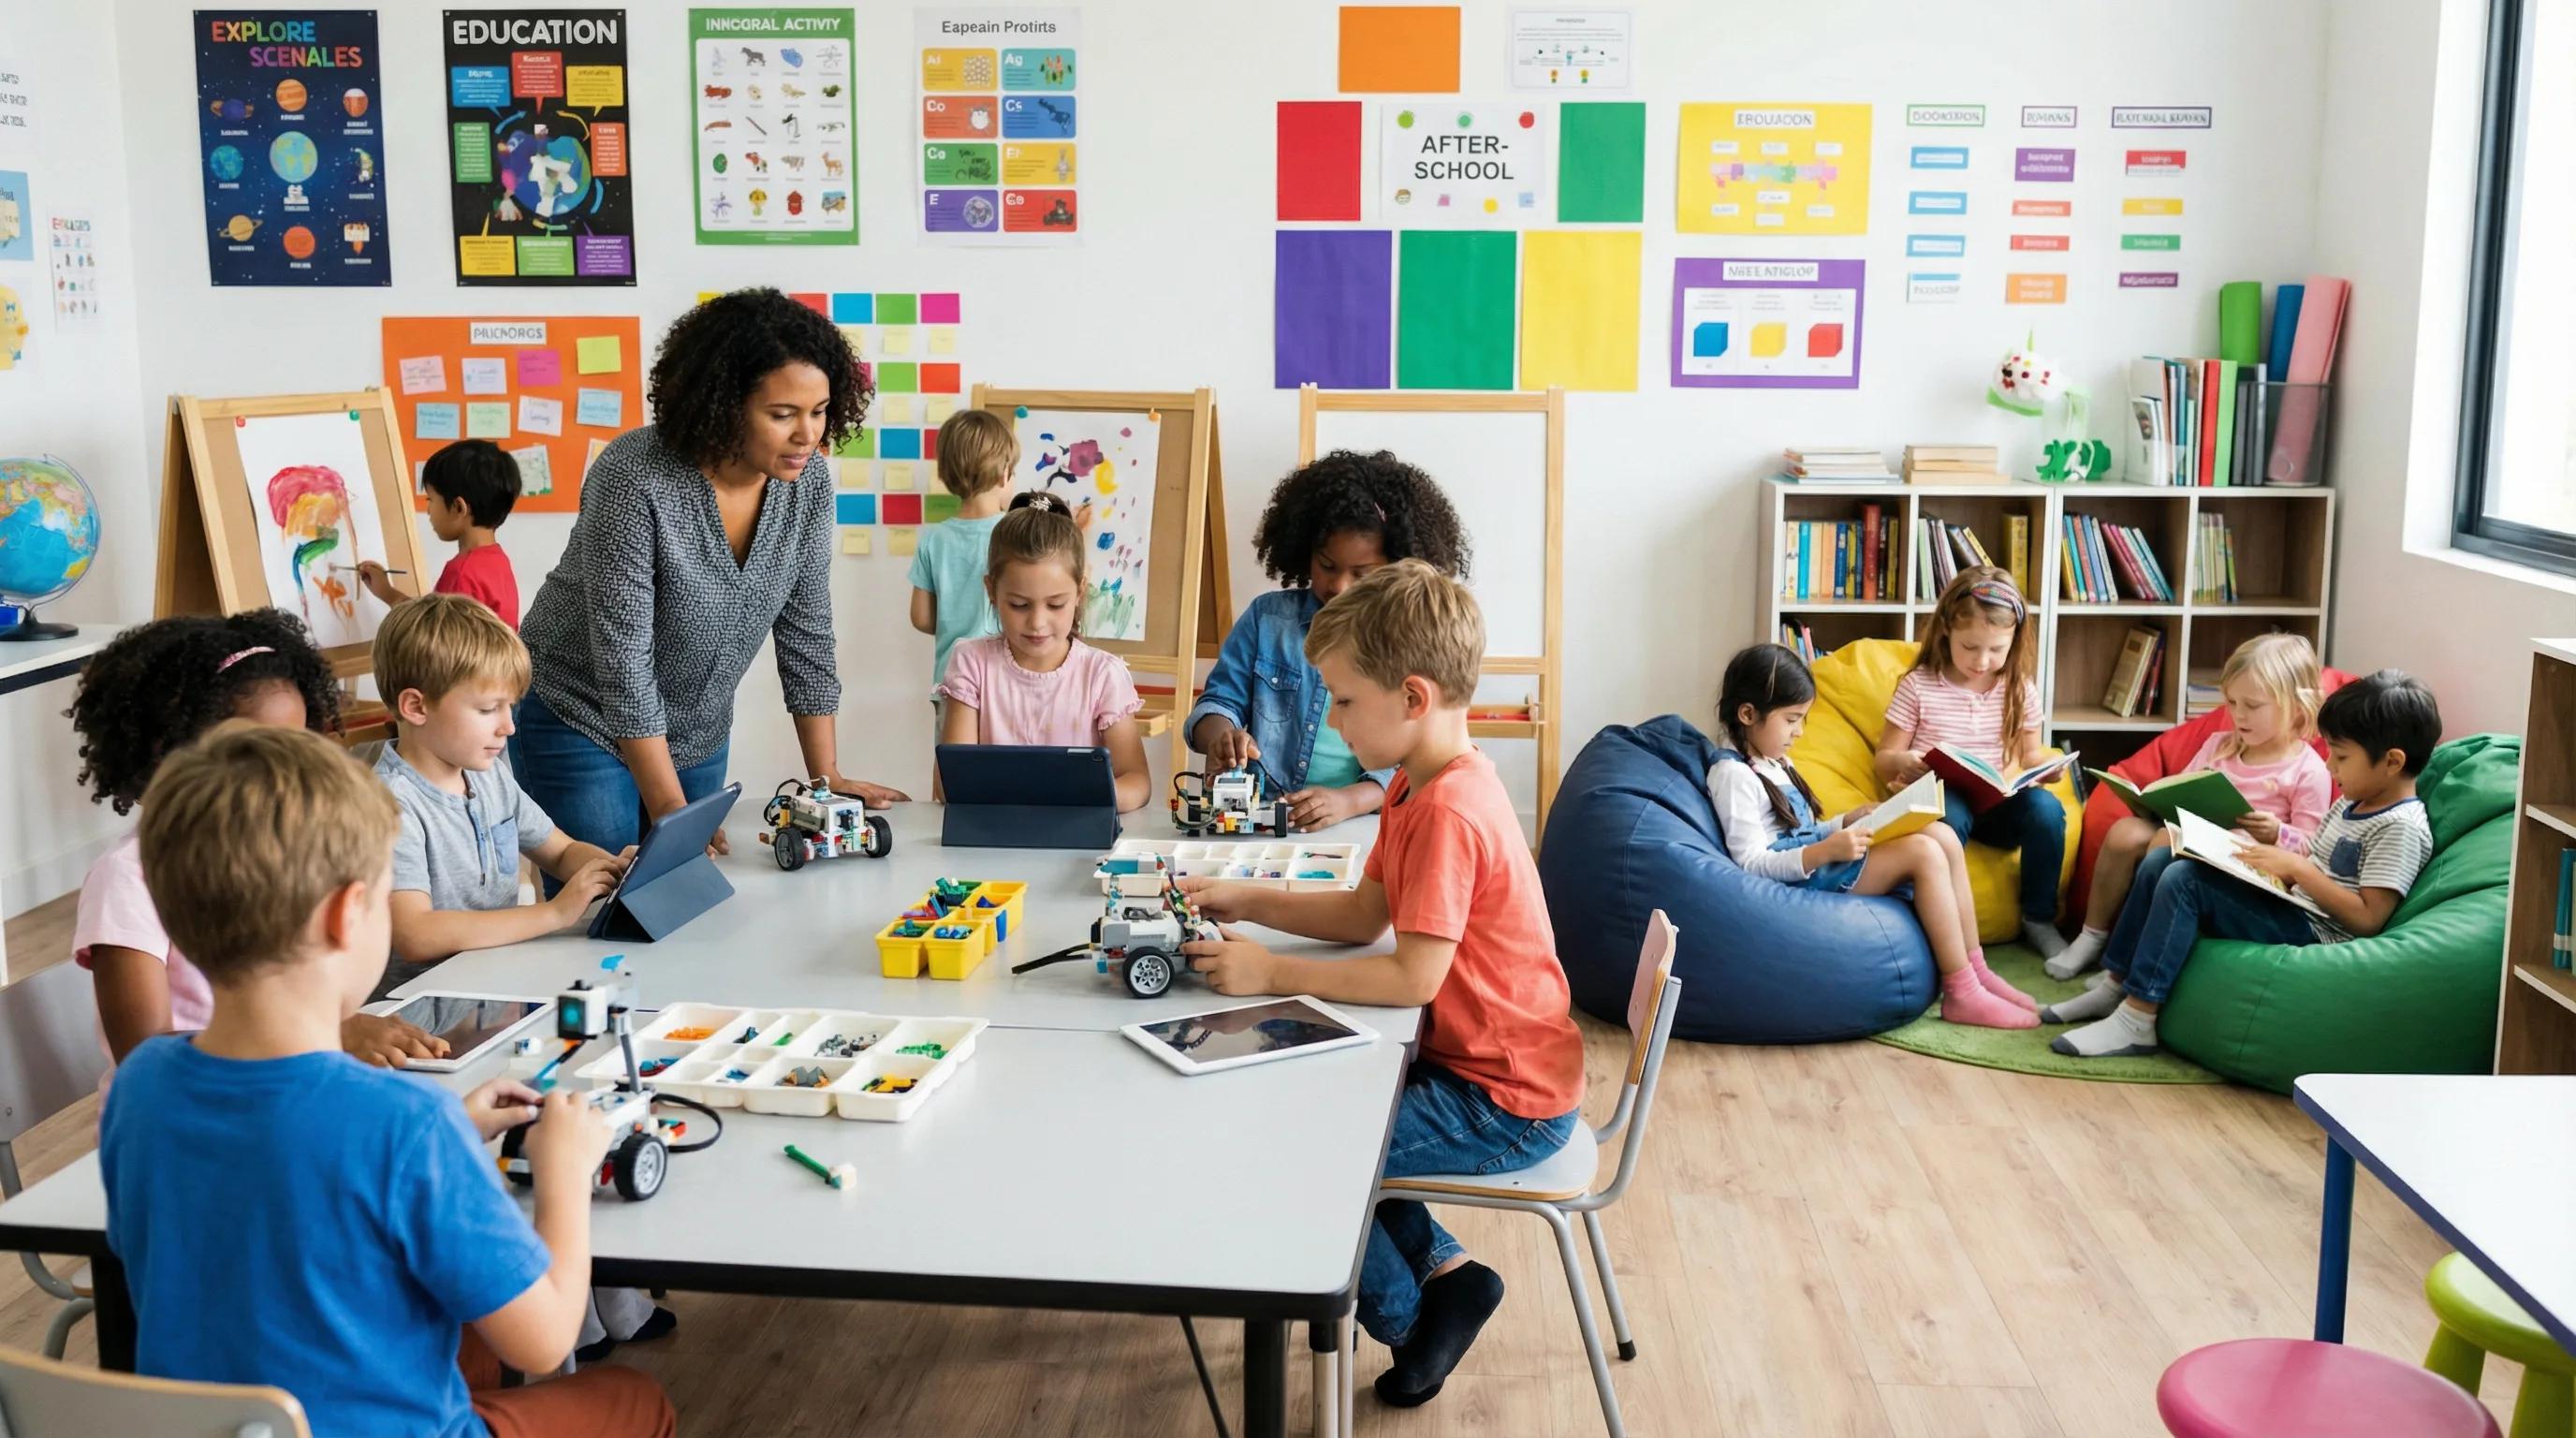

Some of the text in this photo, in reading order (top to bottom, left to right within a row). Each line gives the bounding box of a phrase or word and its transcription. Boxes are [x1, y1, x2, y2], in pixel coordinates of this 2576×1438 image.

[212, 21, 316, 42] EXPLORE
[453, 19, 618, 45] EDUCATION
[942, 21, 1000, 36] Eapeain
[249, 46, 364, 67] SCENALES
[1421, 135, 1509, 154] AFTER-
[1414, 161, 1515, 180] SCHOOL
[929, 194, 939, 205] E
